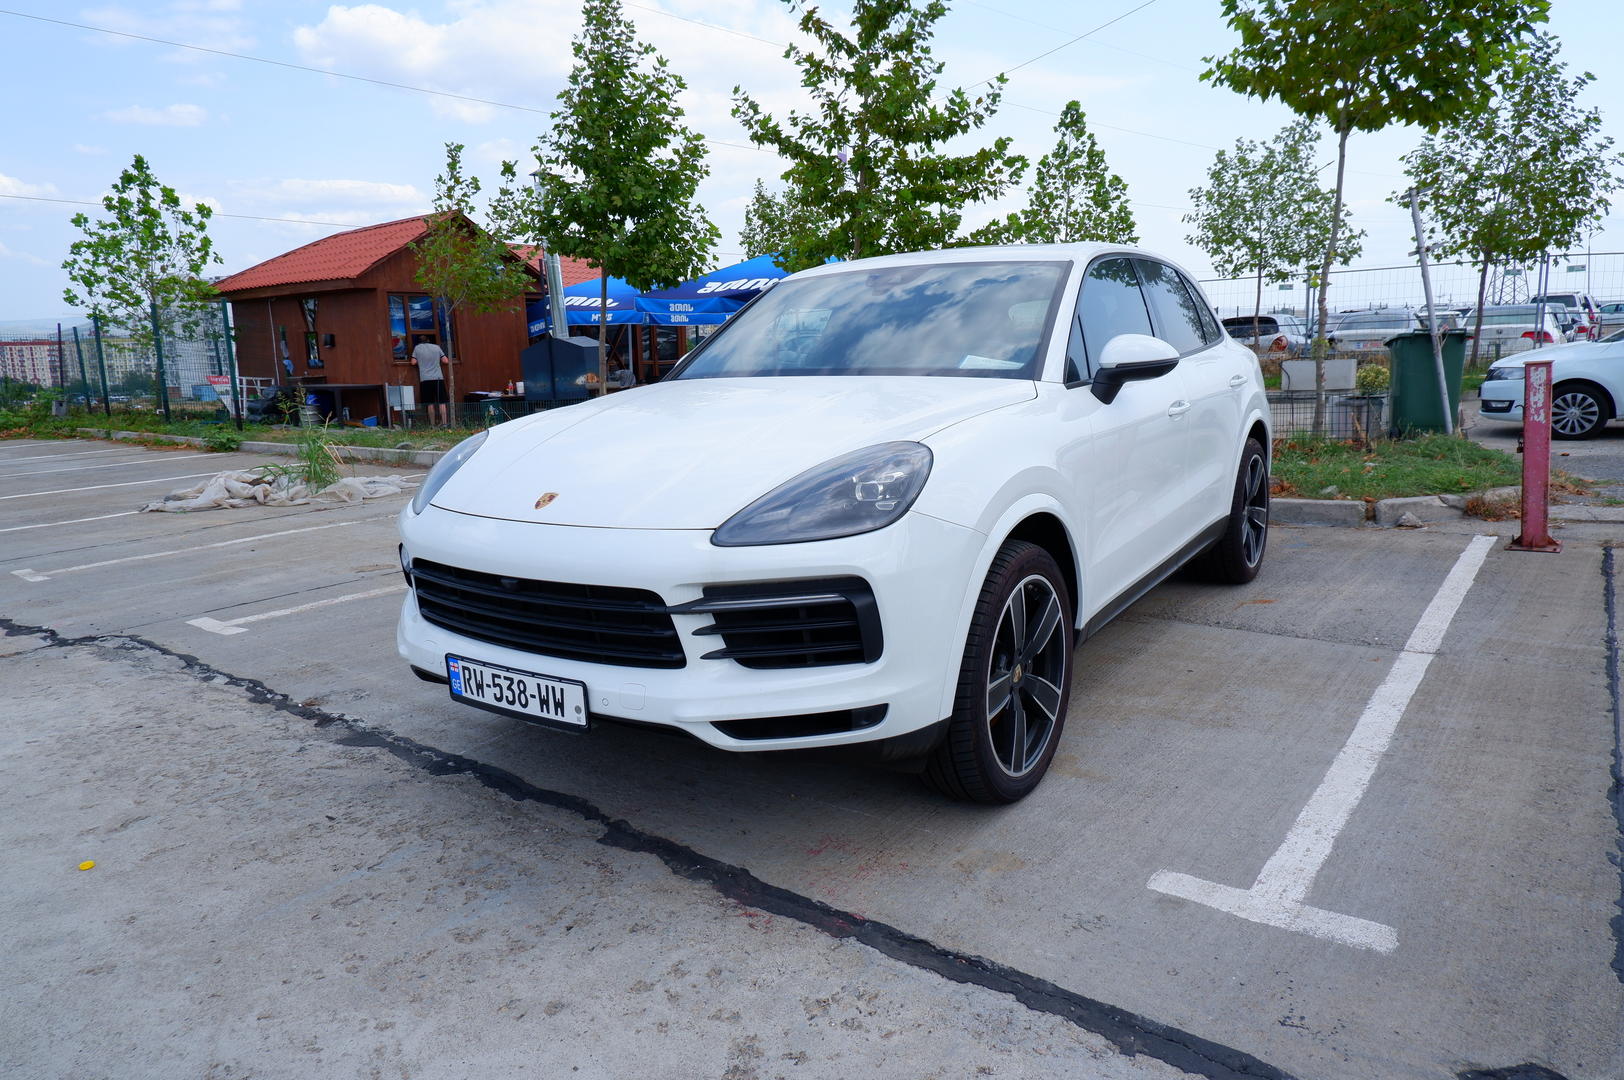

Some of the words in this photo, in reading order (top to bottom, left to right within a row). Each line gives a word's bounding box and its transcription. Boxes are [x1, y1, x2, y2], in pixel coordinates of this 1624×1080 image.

[546, 296, 619, 309] თის
[452, 678, 462, 691] GE
[461, 665, 566, 718] RW-538-WW
